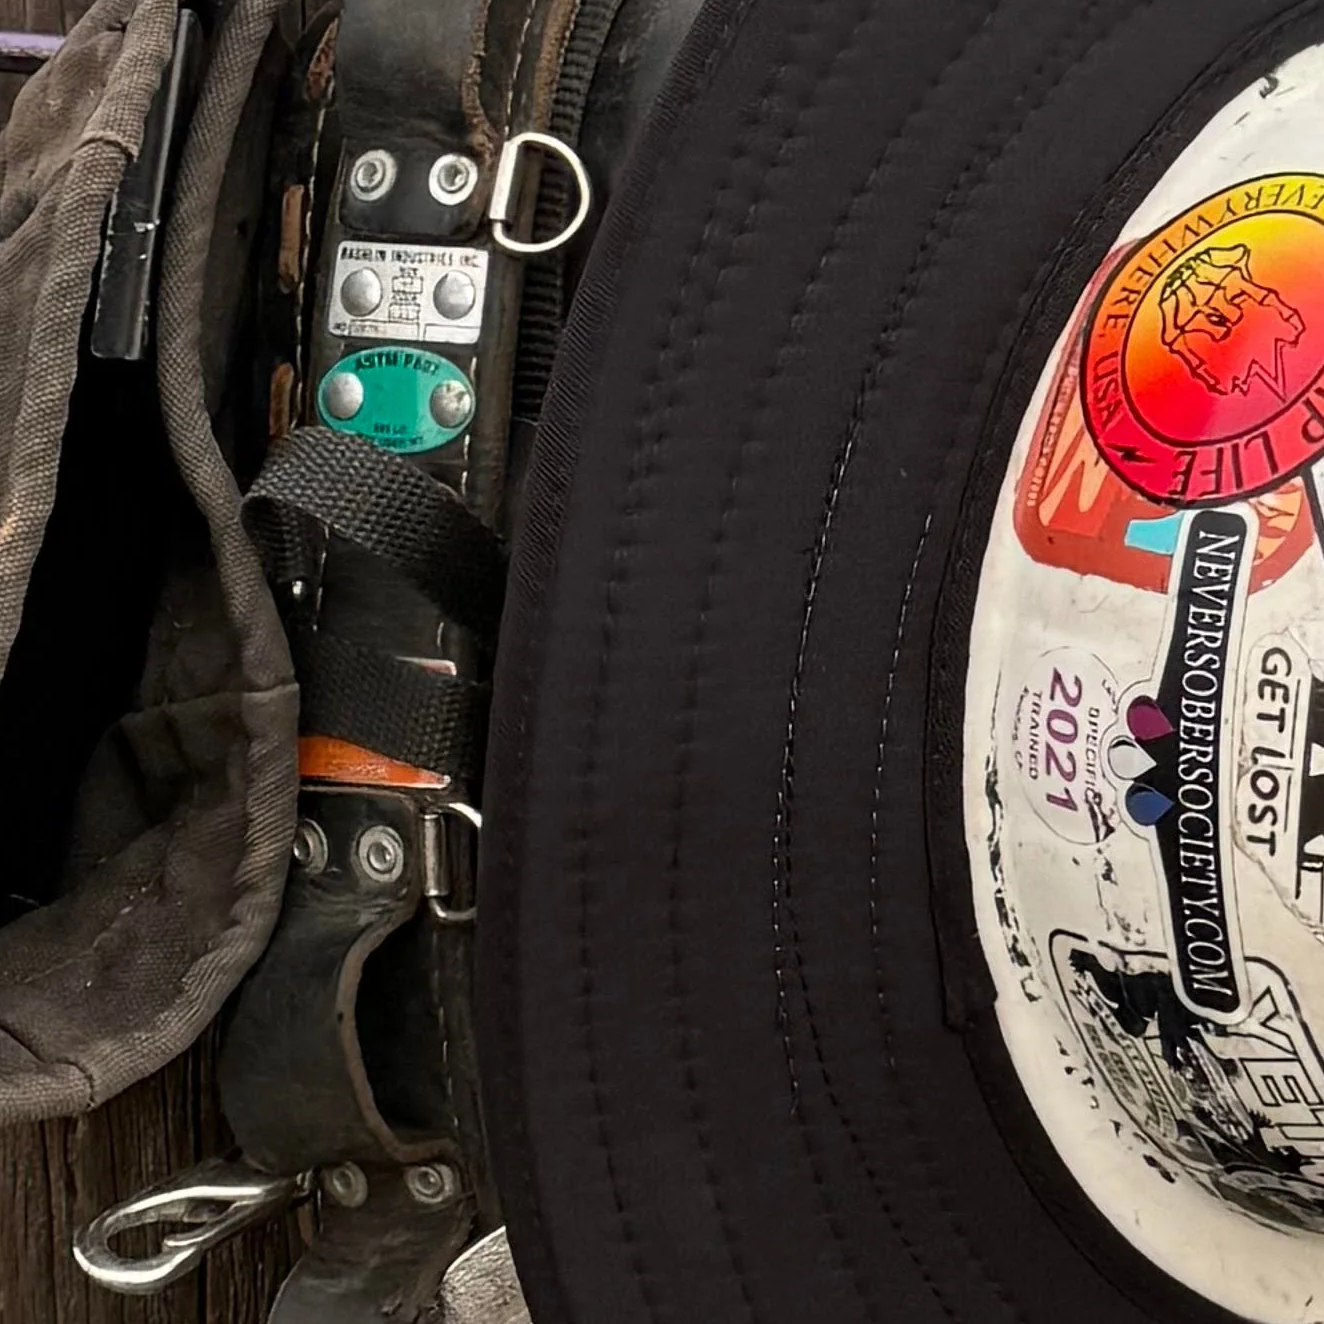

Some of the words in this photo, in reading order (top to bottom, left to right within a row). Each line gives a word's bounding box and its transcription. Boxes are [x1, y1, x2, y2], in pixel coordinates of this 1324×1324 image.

[1091, 351, 1125, 428] USA
[1170, 433, 1279, 501] LIFE
[1044, 667, 1084, 814] 2021
[1257, 646, 1292, 736] GET
[1181, 531, 1240, 997] NEVERSOBERSOCIETY.COM
[1247, 744, 1283, 856] LOST
